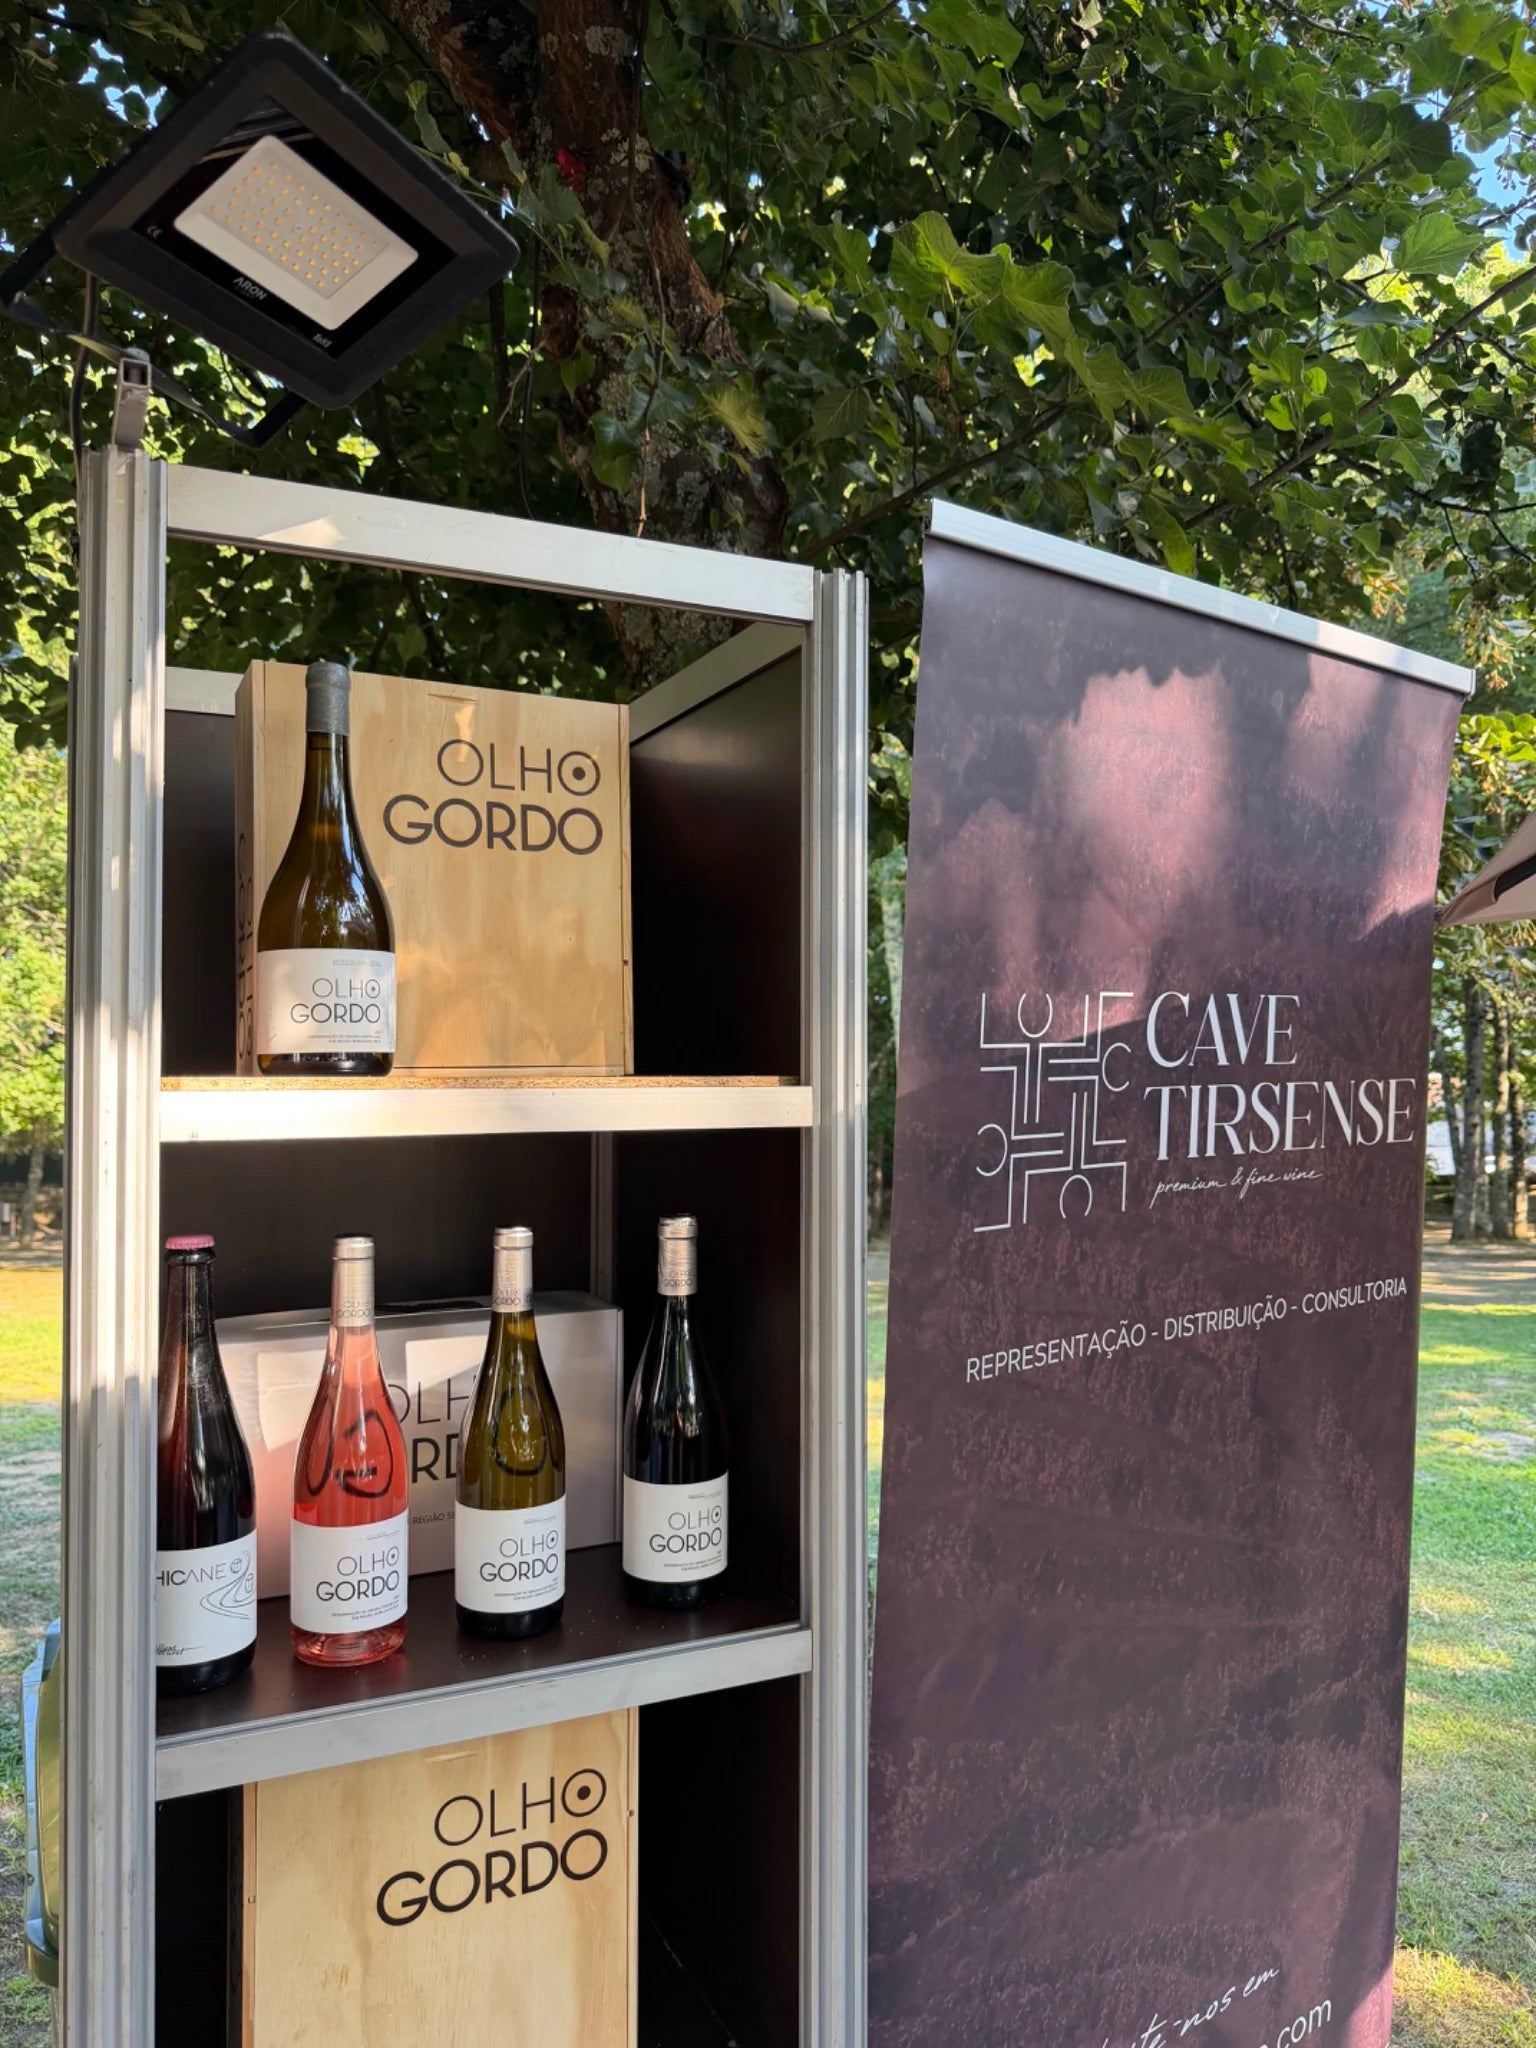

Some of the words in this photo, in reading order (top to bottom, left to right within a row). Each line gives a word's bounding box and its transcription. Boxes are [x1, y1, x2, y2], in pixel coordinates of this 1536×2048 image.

[437, 739, 601, 797] OLHO
[383, 794, 603, 856] GORDO
[312, 977, 381, 999] OLHO
[290, 1002, 381, 1024] GORDO
[1146, 991, 1300, 1068] CAVE
[1143, 1077, 1416, 1161] TIRSENSE
[1149, 1176, 1227, 1209] premium
[1239, 1168, 1280, 1199] fine
[1283, 1168, 1324, 1181] wine
[965, 1319, 1147, 1383] REPRESENTAÇÃO
[1163, 1294, 1287, 1341] DISTRIBUIÇÃO
[1301, 1276, 1408, 1315] CONSULTORIA
[388, 1374, 478, 1424] OLH
[668, 1505, 722, 1531] OLHO
[499, 1529, 559, 1558] OLHO
[649, 1527, 722, 1554] GORDO
[156, 1562, 227, 1587] HICANE
[336, 1545, 400, 1576] OLHO
[479, 1552, 559, 1582] GORDO
[316, 1569, 400, 1602] GORDO
[434, 1768, 607, 1846] OLHO
[376, 1828, 608, 1927] GORDO
[1242, 1966, 1280, 1997] em
